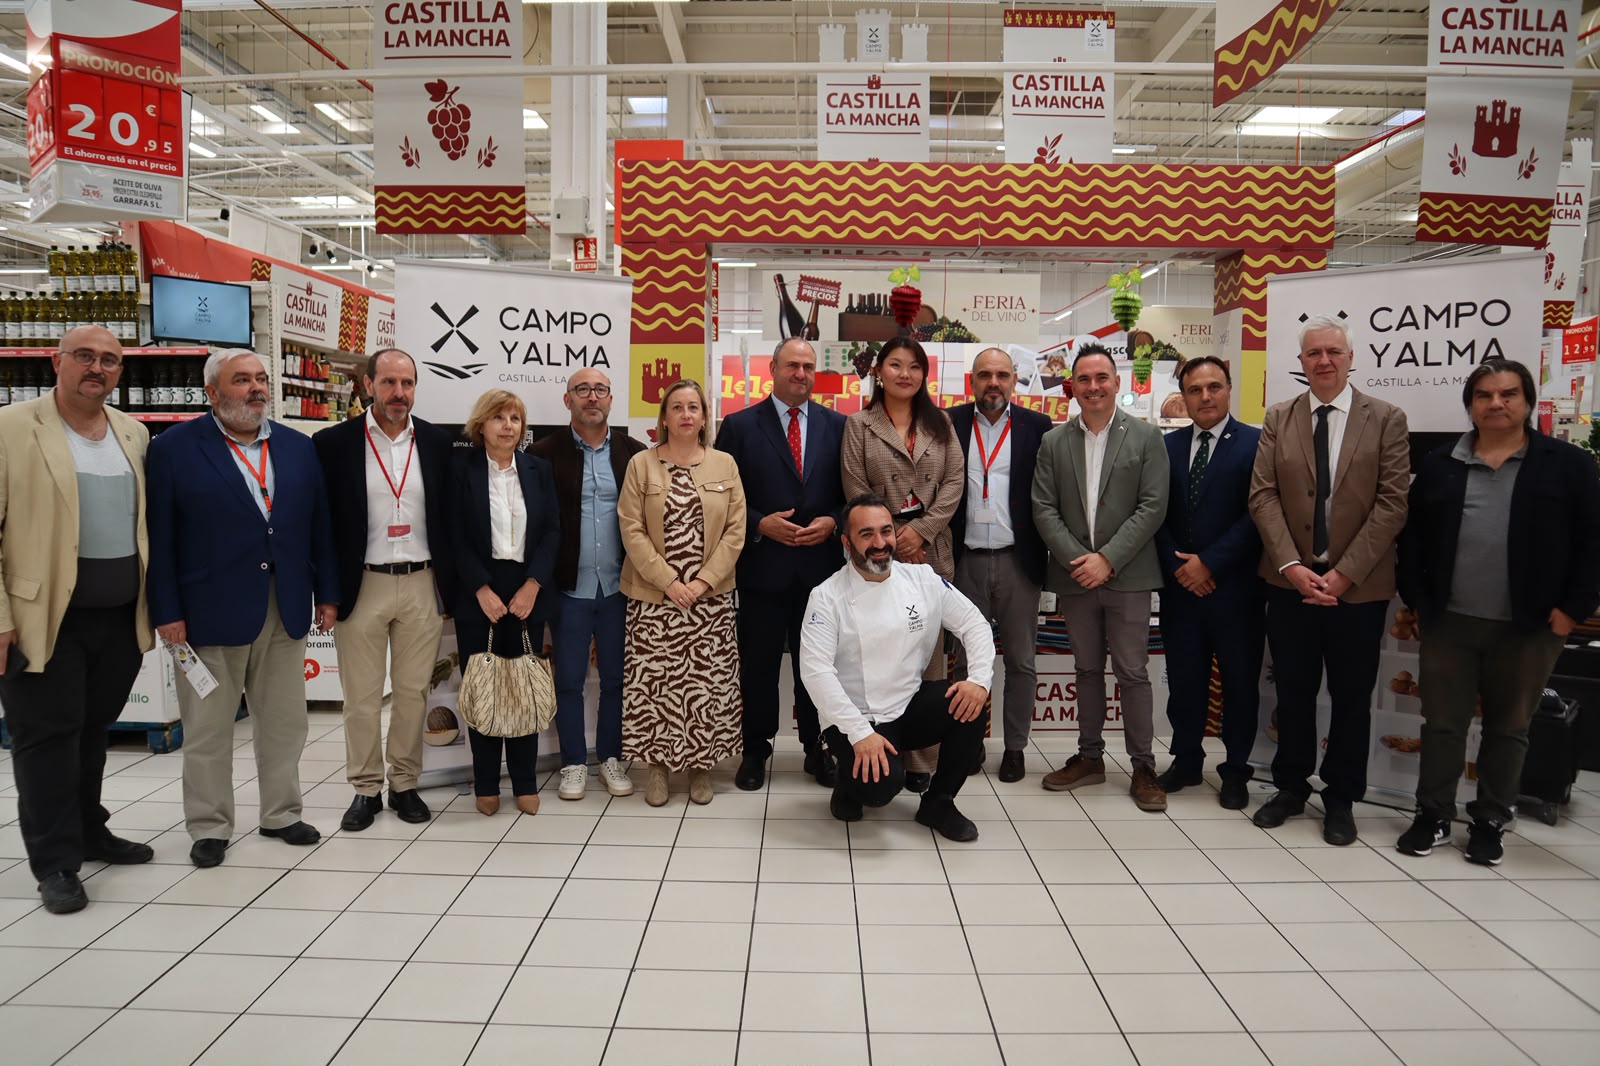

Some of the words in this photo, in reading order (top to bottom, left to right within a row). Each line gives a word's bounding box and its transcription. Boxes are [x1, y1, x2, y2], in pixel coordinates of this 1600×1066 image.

[385, 1, 511, 24] CASTILLA
[1441, 7, 1568, 33] CASTILLA
[384, 30, 410, 48] LA
[415, 29, 510, 47] MANCHA
[1439, 36, 1467, 54] LA
[1472, 36, 1564, 57] MANCHA
[63, 50, 179, 86] PROMOCIÓN
[1012, 74, 1105, 92] CASTILLA
[826, 93, 921, 108] CASTILLA
[1012, 94, 1031, 107] LA
[1035, 96, 1105, 109] MANCHA
[826, 112, 846, 125] LA
[850, 113, 920, 126] MANCHA
[64, 147, 74, 155] El
[75, 149, 105, 161] ahorro
[107, 155, 125, 164] está
[127, 158, 139, 166] en
[140, 158, 149, 168] el
[150, 160, 177, 172] precio
[113, 178, 134, 188] ACEITE
[135, 181, 144, 189] DE
[144, 182, 163, 192] OLIVA
[113, 196, 149, 207] GARRAFA
[801, 289, 837, 302] PRECIOS
[973, 295, 1026, 309] FERIA
[286, 293, 327, 318] CASTILLA
[283, 312, 295, 326] LA
[295, 315, 326, 333] MANCHA
[499, 306, 612, 336] CAMPO
[971, 311, 993, 321] DEL
[997, 311, 1027, 322] VINO
[1369, 299, 1511, 332] CAMPO
[1181, 324, 1213, 335] FERI
[376, 336, 383, 346] LA
[1180, 336, 1197, 344] DEL
[1200, 336, 1213, 344] VIN
[498, 374, 546, 383] CASTILLA
[555, 376, 567, 384] LA
[1367, 377, 1420, 387] CASTILLA
[1433, 377, 1450, 386] LA
